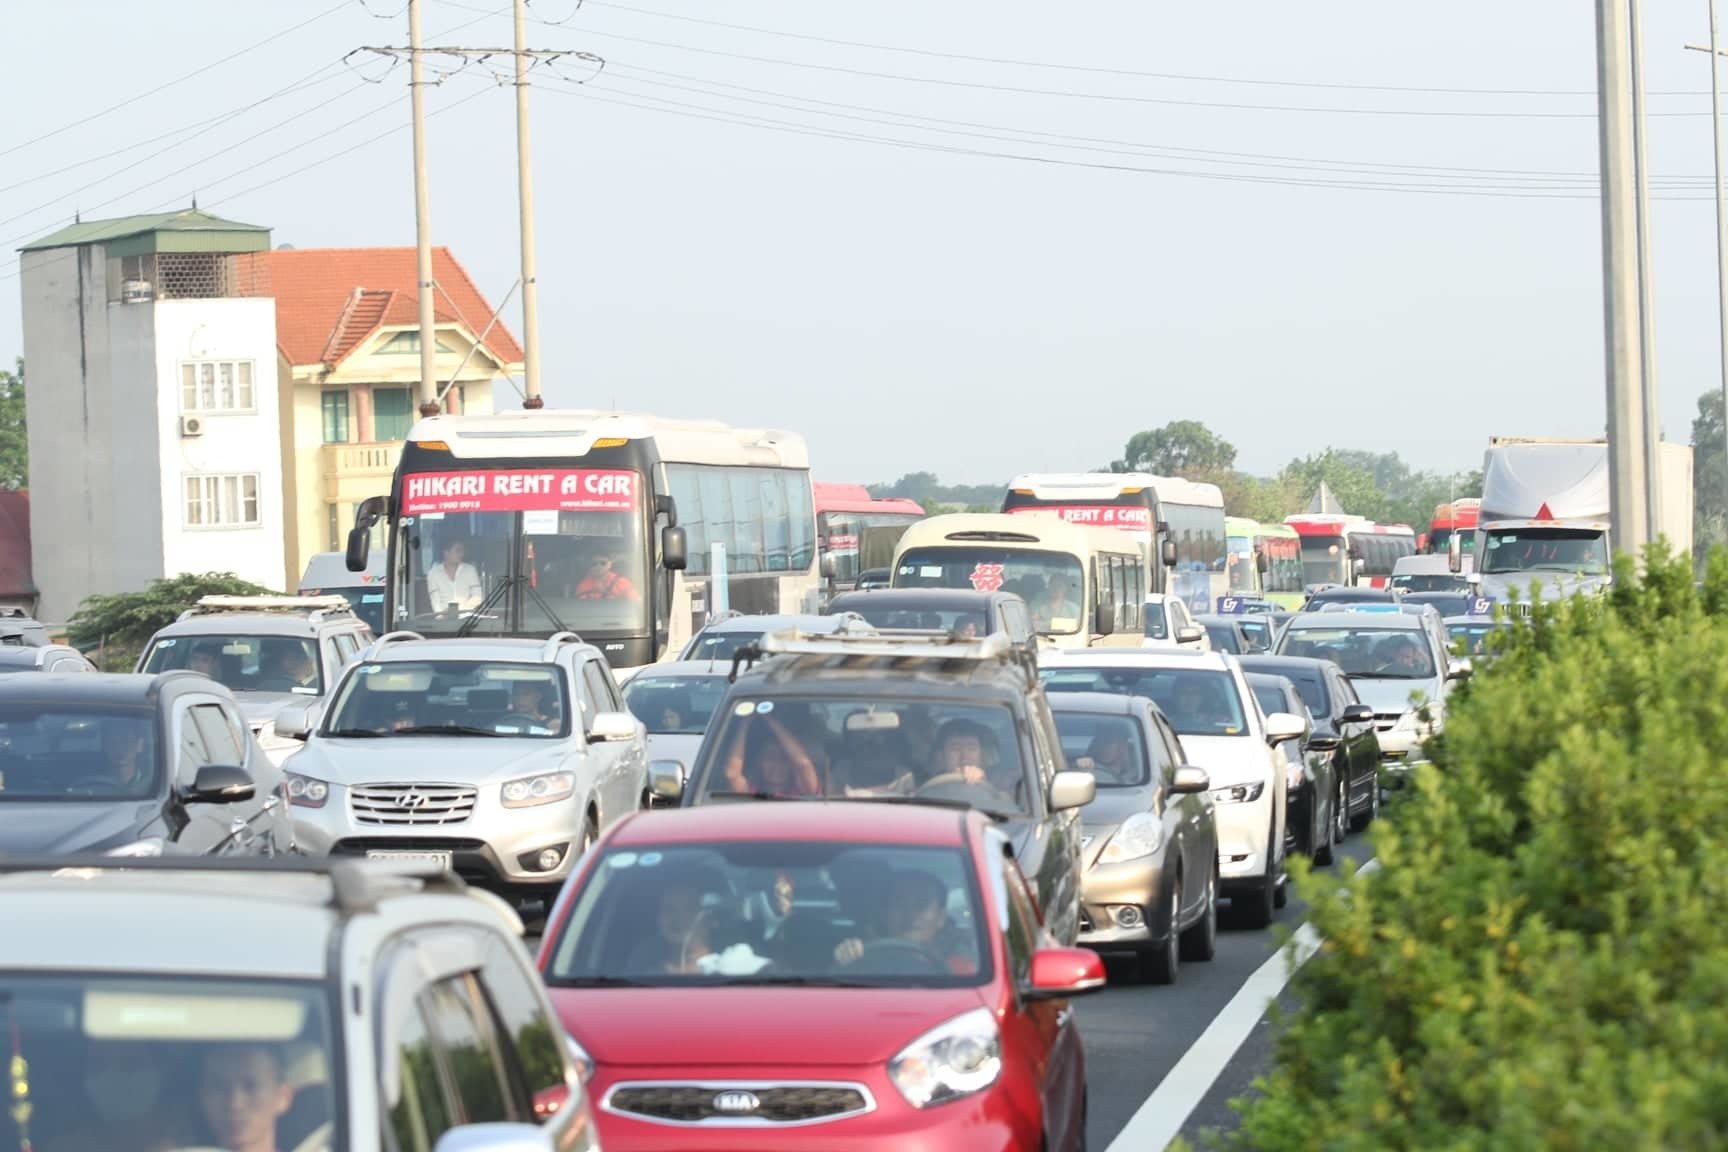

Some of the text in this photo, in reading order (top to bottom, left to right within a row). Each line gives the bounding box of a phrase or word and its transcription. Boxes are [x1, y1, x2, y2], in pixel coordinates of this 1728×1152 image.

[409, 474, 632, 499] HIKARI RENT A CAR
[1063, 508, 1146, 522] RENT A CAR
[720, 1094, 752, 1111] KIA
